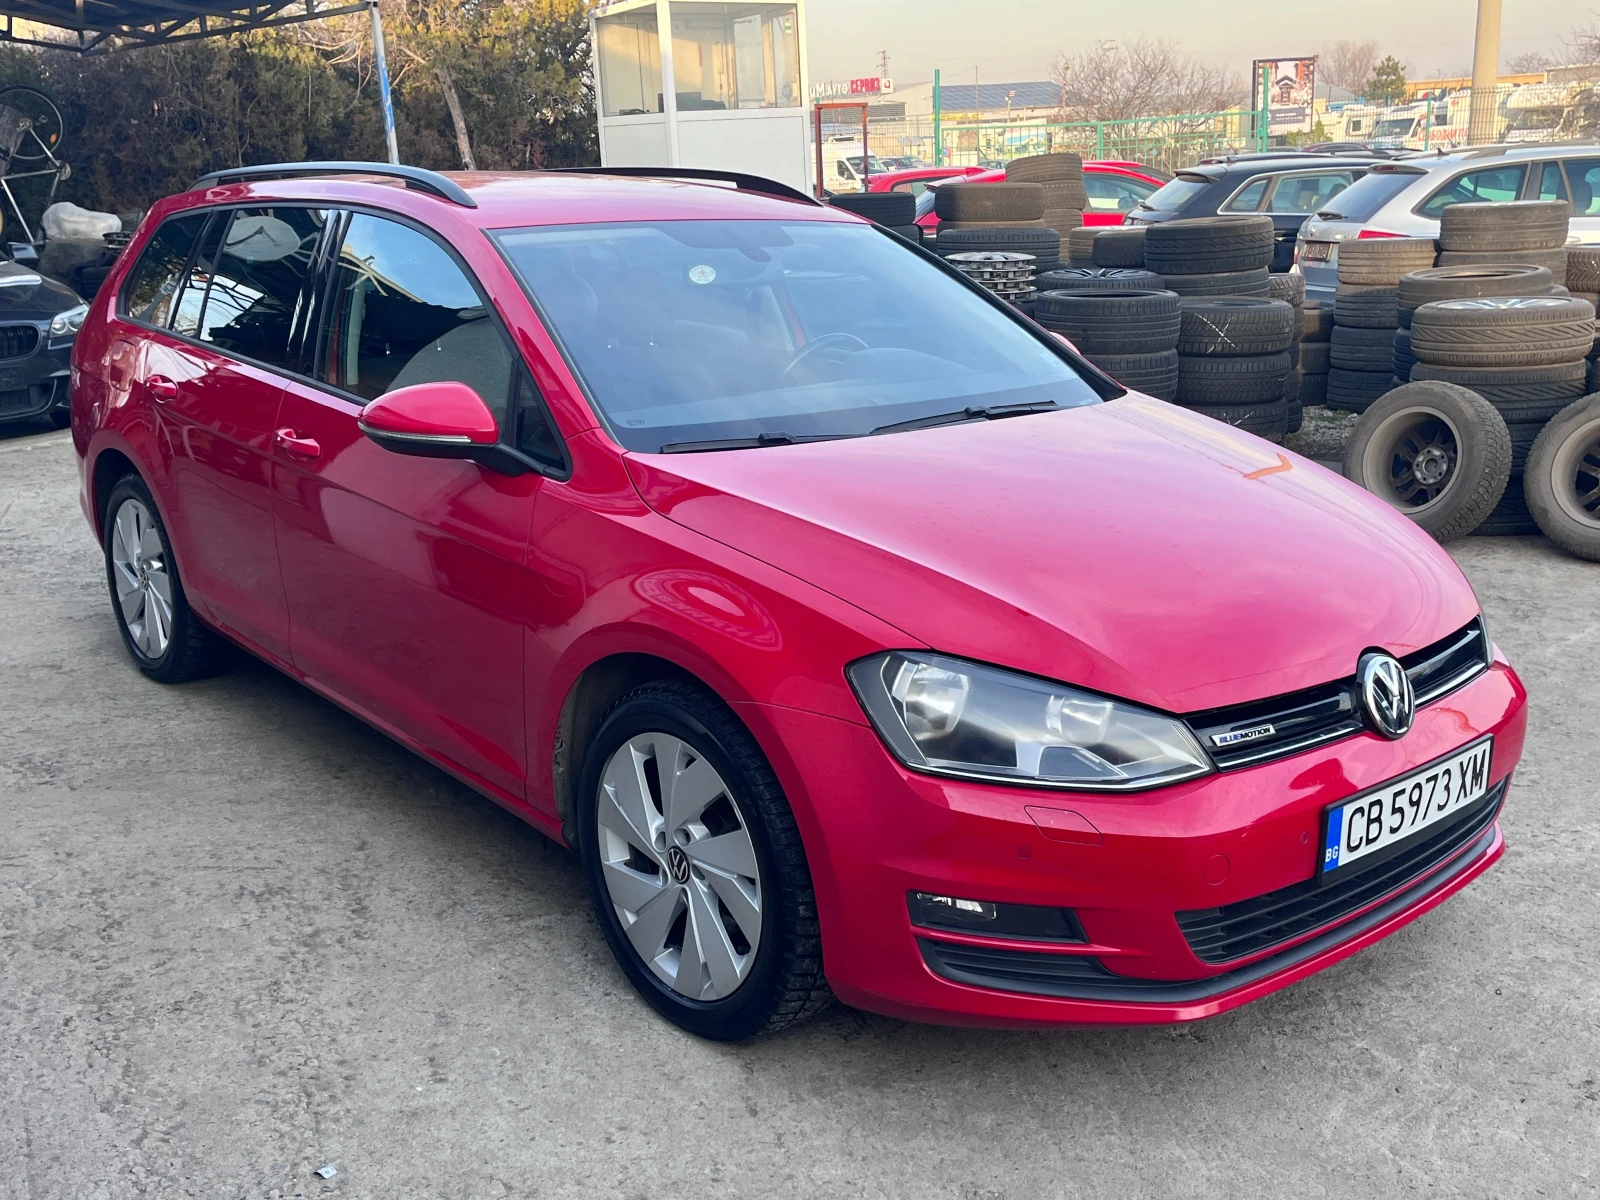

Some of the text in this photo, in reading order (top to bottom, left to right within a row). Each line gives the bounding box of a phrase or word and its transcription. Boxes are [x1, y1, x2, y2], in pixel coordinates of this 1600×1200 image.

[850, 77, 881, 94] СЕРВИЗ
[1218, 725, 1271, 745] BLUEMOTION
[1325, 845, 1339, 862] BG
